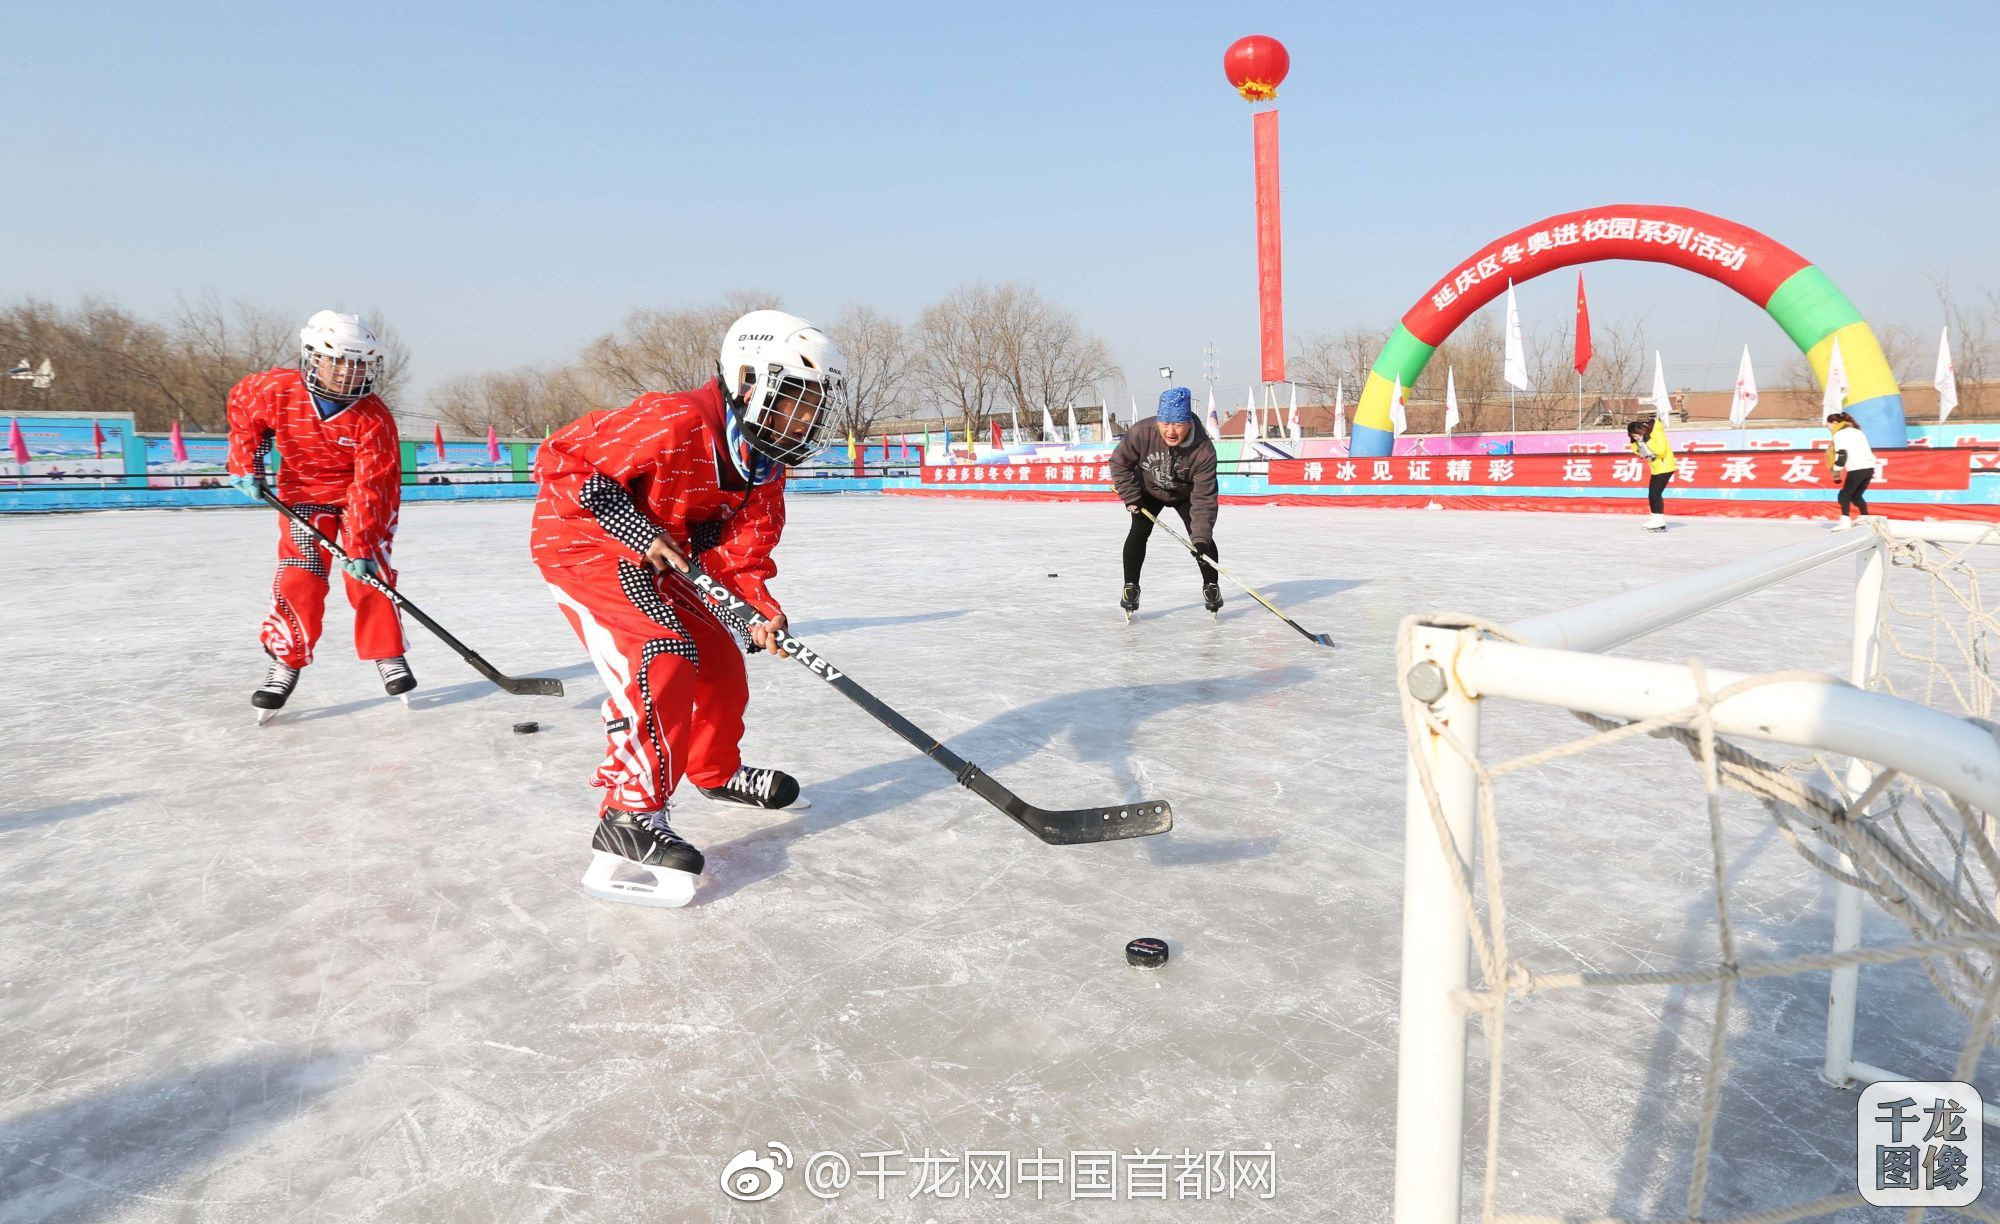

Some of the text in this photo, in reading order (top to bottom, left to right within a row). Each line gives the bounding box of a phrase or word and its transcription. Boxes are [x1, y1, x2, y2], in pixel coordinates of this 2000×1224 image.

[1431, 217, 1748, 312] 延庆区冬奥进校园系列活动
[934, 467, 1031, 482] 多姿多彩冬令营
[1303, 459, 1515, 482] 滑冰见证精彩
[694, 574, 744, 610] ROY
